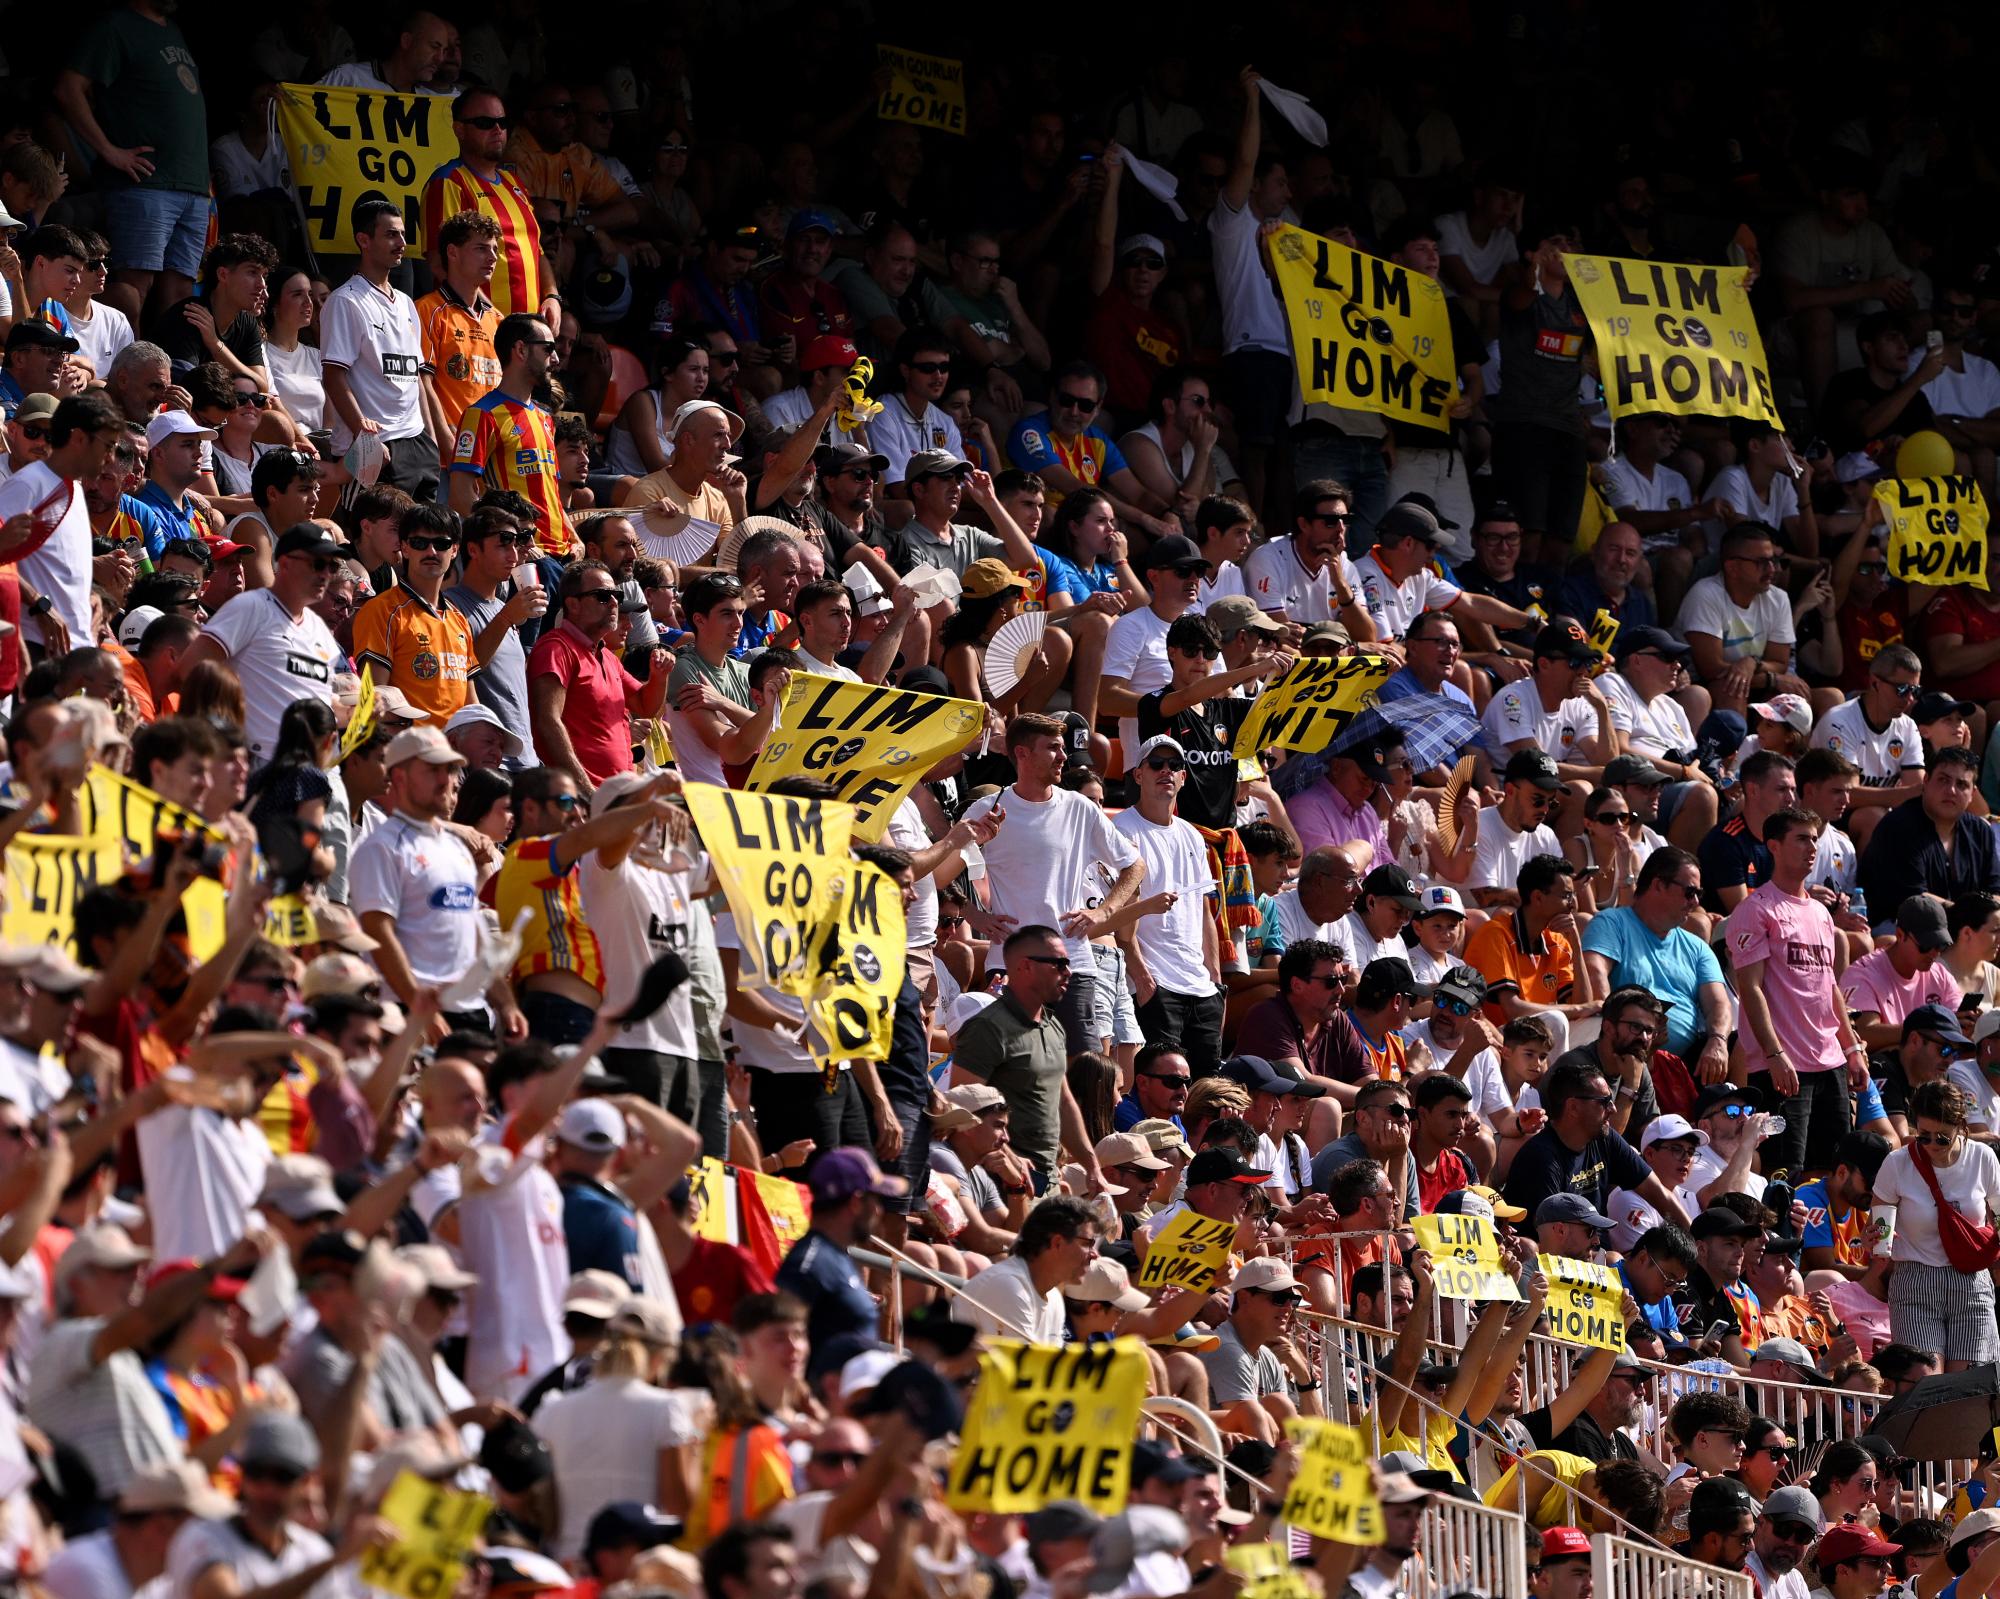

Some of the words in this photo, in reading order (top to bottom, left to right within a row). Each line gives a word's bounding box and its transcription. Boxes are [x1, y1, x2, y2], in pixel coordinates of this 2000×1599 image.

[907, 55, 961, 83] GOURLAY
[312, 91, 431, 147] LIM
[881, 91, 963, 128] HOME
[357, 147, 416, 186] GO
[1313, 240, 1411, 318] LIM
[1609, 261, 1722, 315] LIM
[1340, 302, 1394, 346] GO
[1541, 335, 1561, 350] TM
[1655, 313, 1713, 349] GO
[385, 359, 401, 371] TM
[1312, 337, 1451, 417] HOME
[1615, 353, 1775, 418] HOME
[1896, 475, 1977, 508] LIM
[1926, 509, 1959, 536] GO
[1899, 541, 1982, 577] HOM
[797, 681, 951, 734] LIM
[1255, 707, 1356, 751] LIM
[762, 743, 794, 765] 19'
[803, 735, 867, 769] GO
[722, 791, 825, 856] LIM
[32, 849, 97, 914] LIM
[443, 884, 472, 907] Ford
[765, 861, 812, 907] GO
[1179, 1219, 1236, 1249] LIM
[1437, 1216, 1482, 1246] LIM
[1143, 1256, 1216, 1287] HOME
[1569, 1289, 1593, 1309] GO
[1548, 1306, 1623, 1347] HOME
[1013, 1345, 1116, 1390] LIM
[1026, 1401, 1075, 1434] GO
[958, 1446, 1120, 1497] HOME
[1288, 1489, 1372, 1534] HOME
